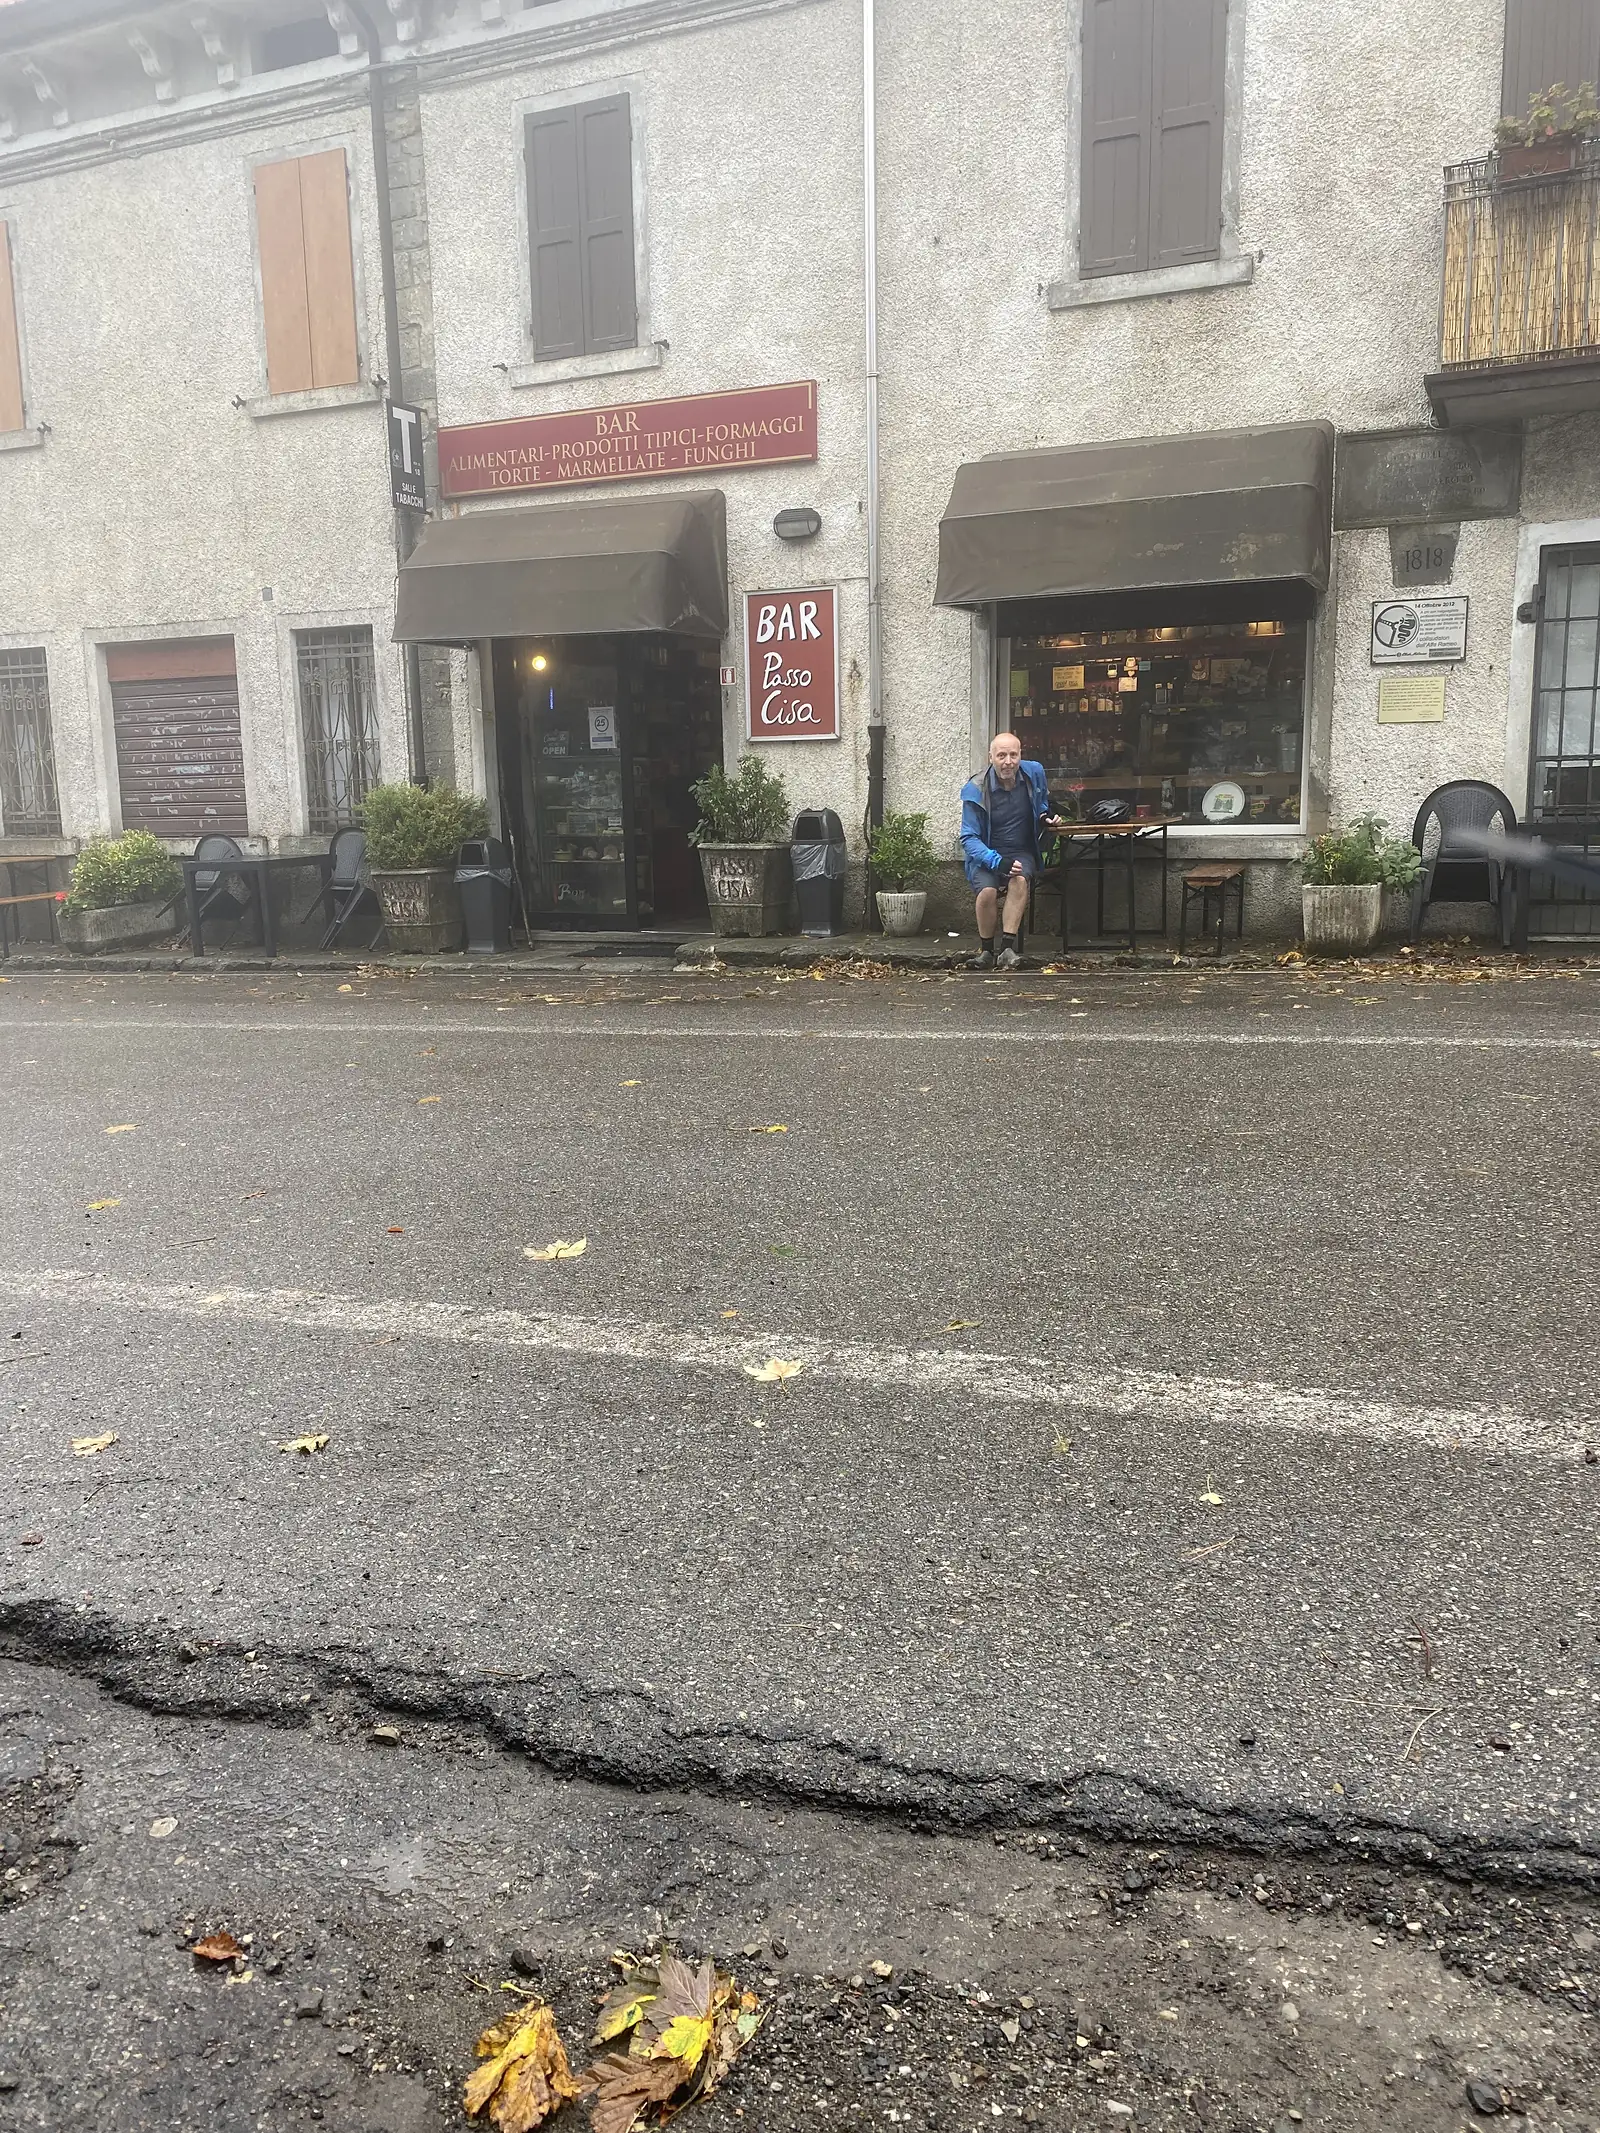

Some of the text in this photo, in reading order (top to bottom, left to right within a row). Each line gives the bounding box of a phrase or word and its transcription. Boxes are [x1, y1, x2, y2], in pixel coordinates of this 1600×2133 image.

[595, 410, 641, 436] BAR
[392, 406, 416, 474] T
[489, 465, 541, 486] TORTE
[557, 451, 666, 479] MARMELLATE
[684, 441, 756, 465] FUNGHI
[395, 492, 424, 509] TABACCHI
[401, 482, 417, 494] SALI E
[1405, 547, 1443, 573] 1818
[756, 600, 822, 643] BAR
[762, 651, 812, 690] Passo
[761, 689, 821, 725] Cisa
[542, 746, 566, 755] OPEN
[709, 857, 756, 875] PASSO
[718, 879, 751, 898] CISA
[391, 901, 420, 919] CISA
